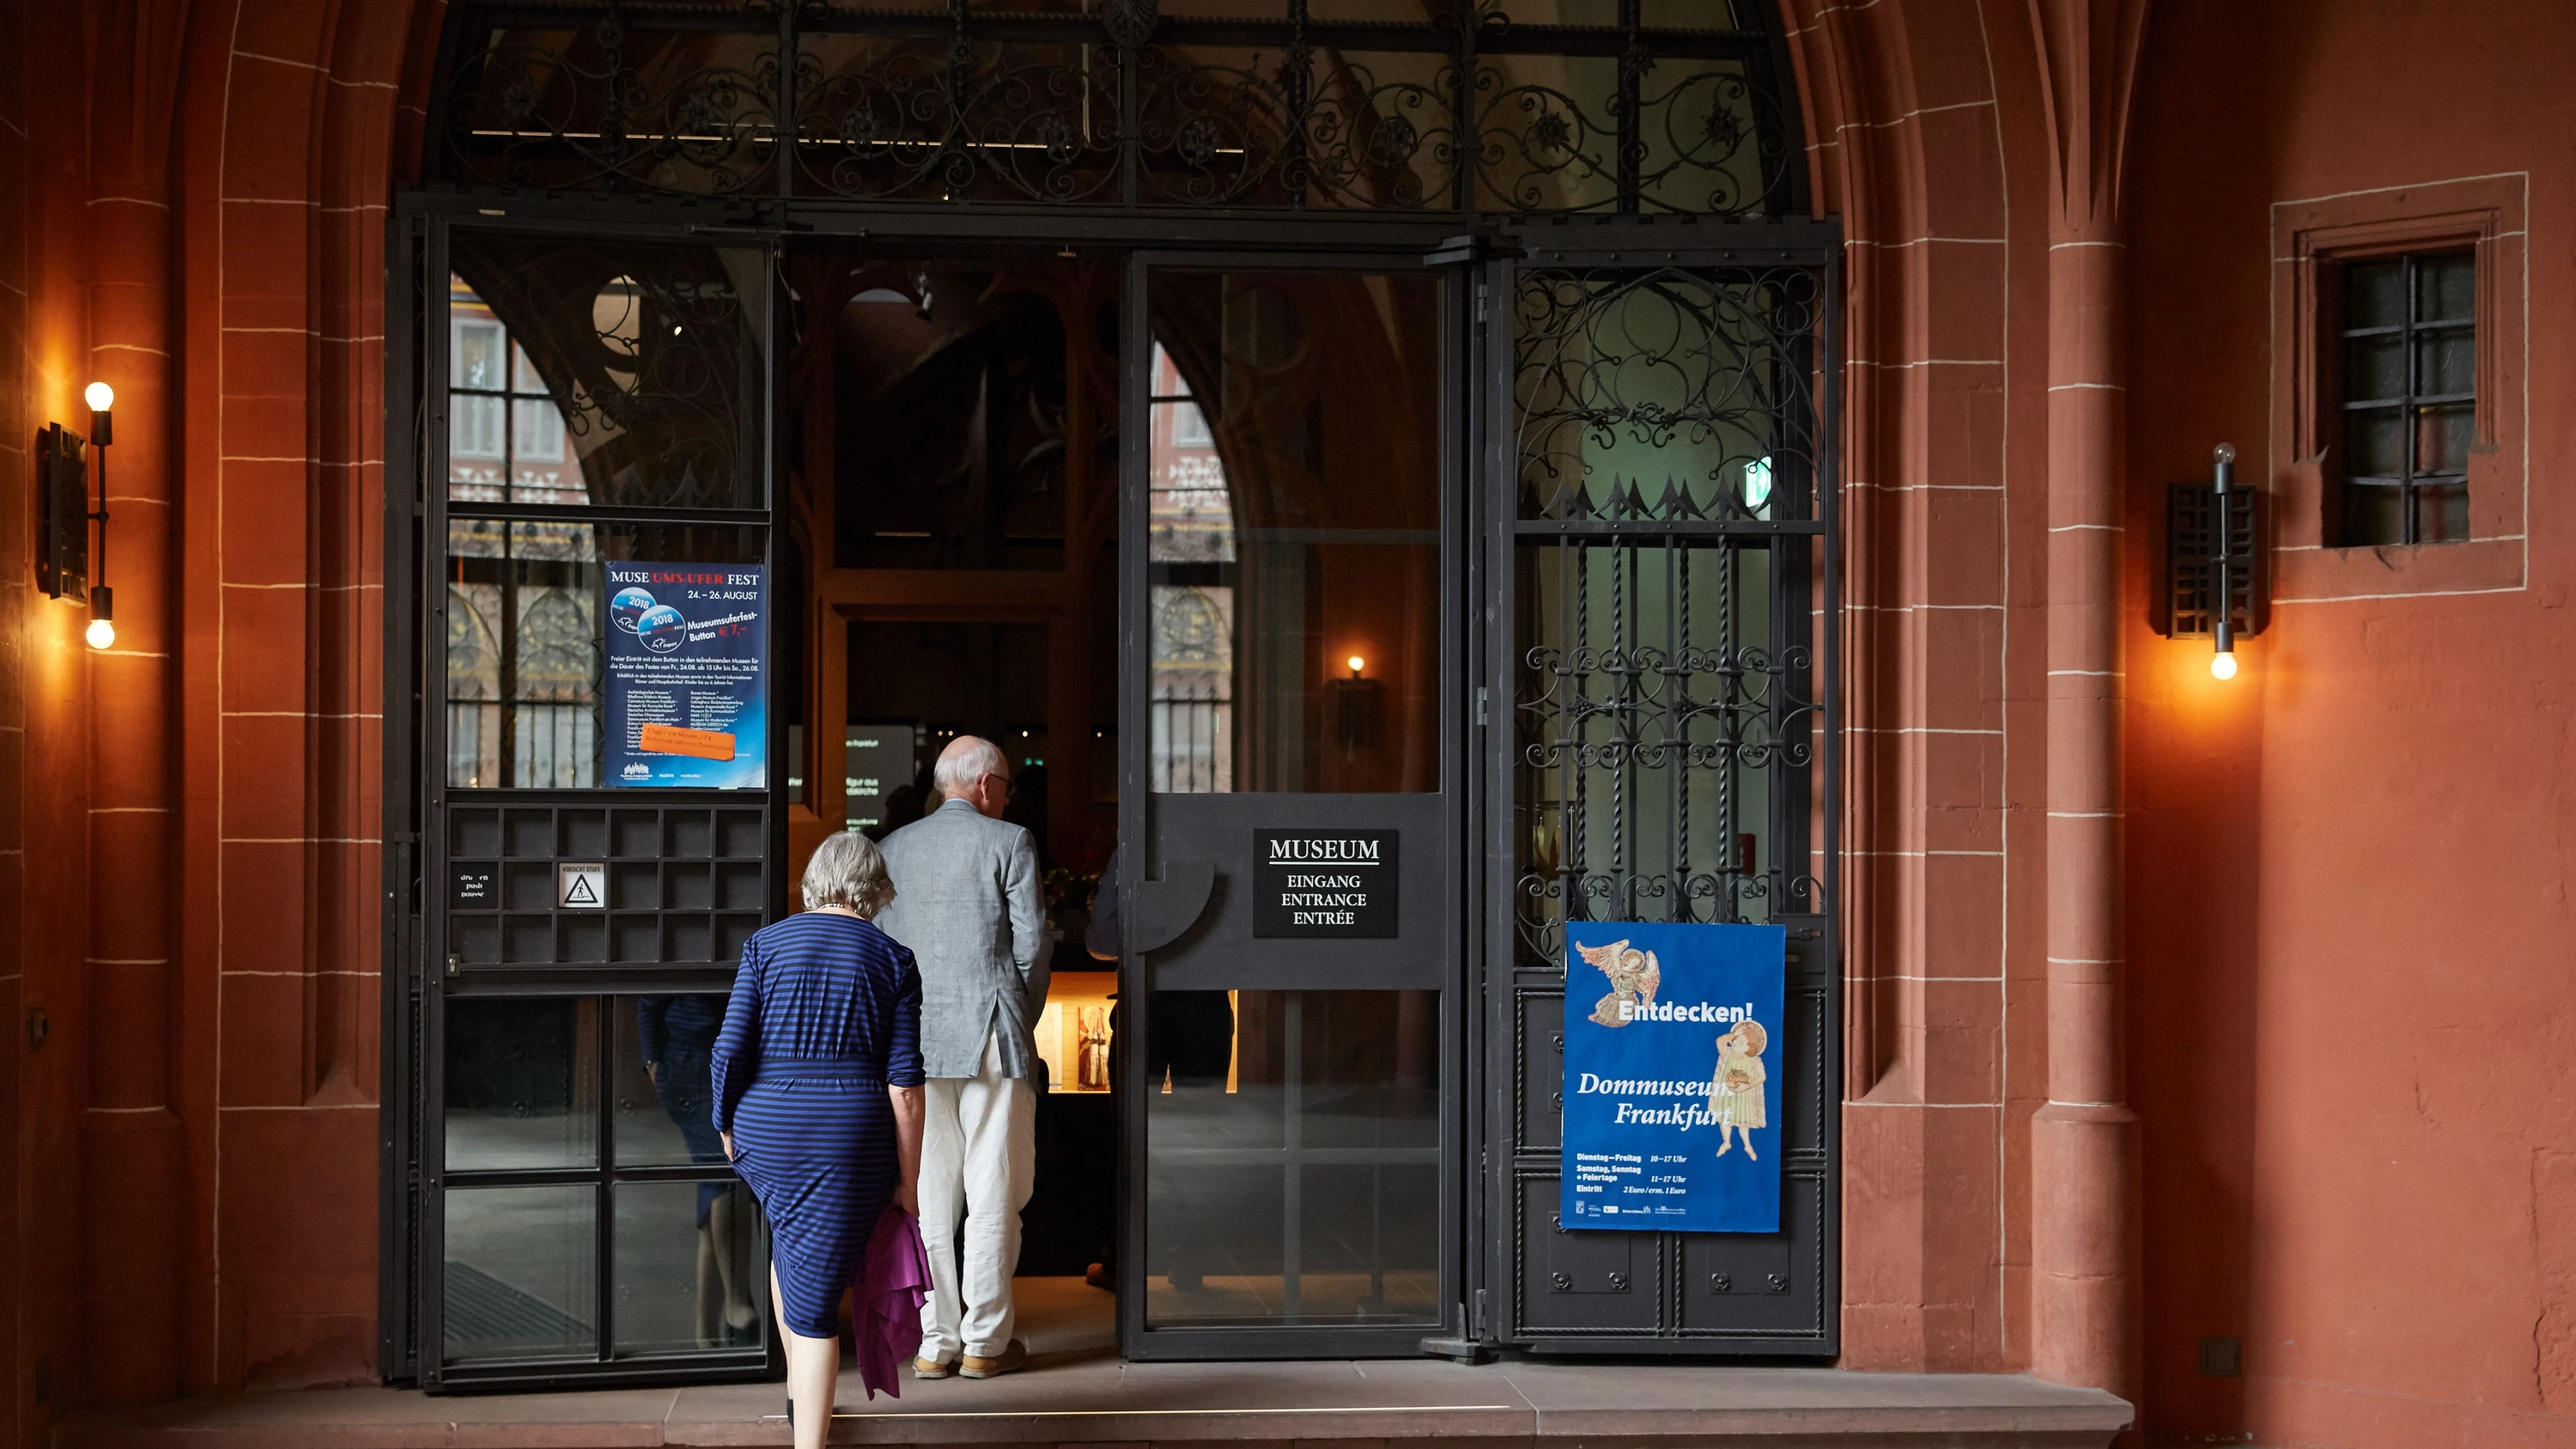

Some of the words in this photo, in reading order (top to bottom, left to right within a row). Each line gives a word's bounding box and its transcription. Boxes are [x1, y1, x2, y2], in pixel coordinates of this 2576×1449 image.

[688, 590, 701, 599] 24.
[709, 591, 721, 599] 26.
[723, 592, 758, 600] AUGUST
[629, 597, 649, 609] 2018
[652, 614, 673, 626] 2018
[688, 612, 758, 630] Museumsuferfest-
[689, 632, 715, 642] Button
[718, 628, 728, 637] €
[1269, 840, 1379, 859] MUSEUM
[1287, 875, 1361, 888] EINGANG
[1281, 894, 1366, 906] ENTRANCE
[1294, 909, 1355, 925] ENTRÉE
[1619, 1000, 1753, 1022] Entdecken!
[1614, 1103, 1732, 1131] Frankfurt
[1576, 1165, 1610, 1173] Samstag,
[1611, 1166, 1641, 1174] Sonntag
[1583, 1174, 1618, 1182] Feiertage
